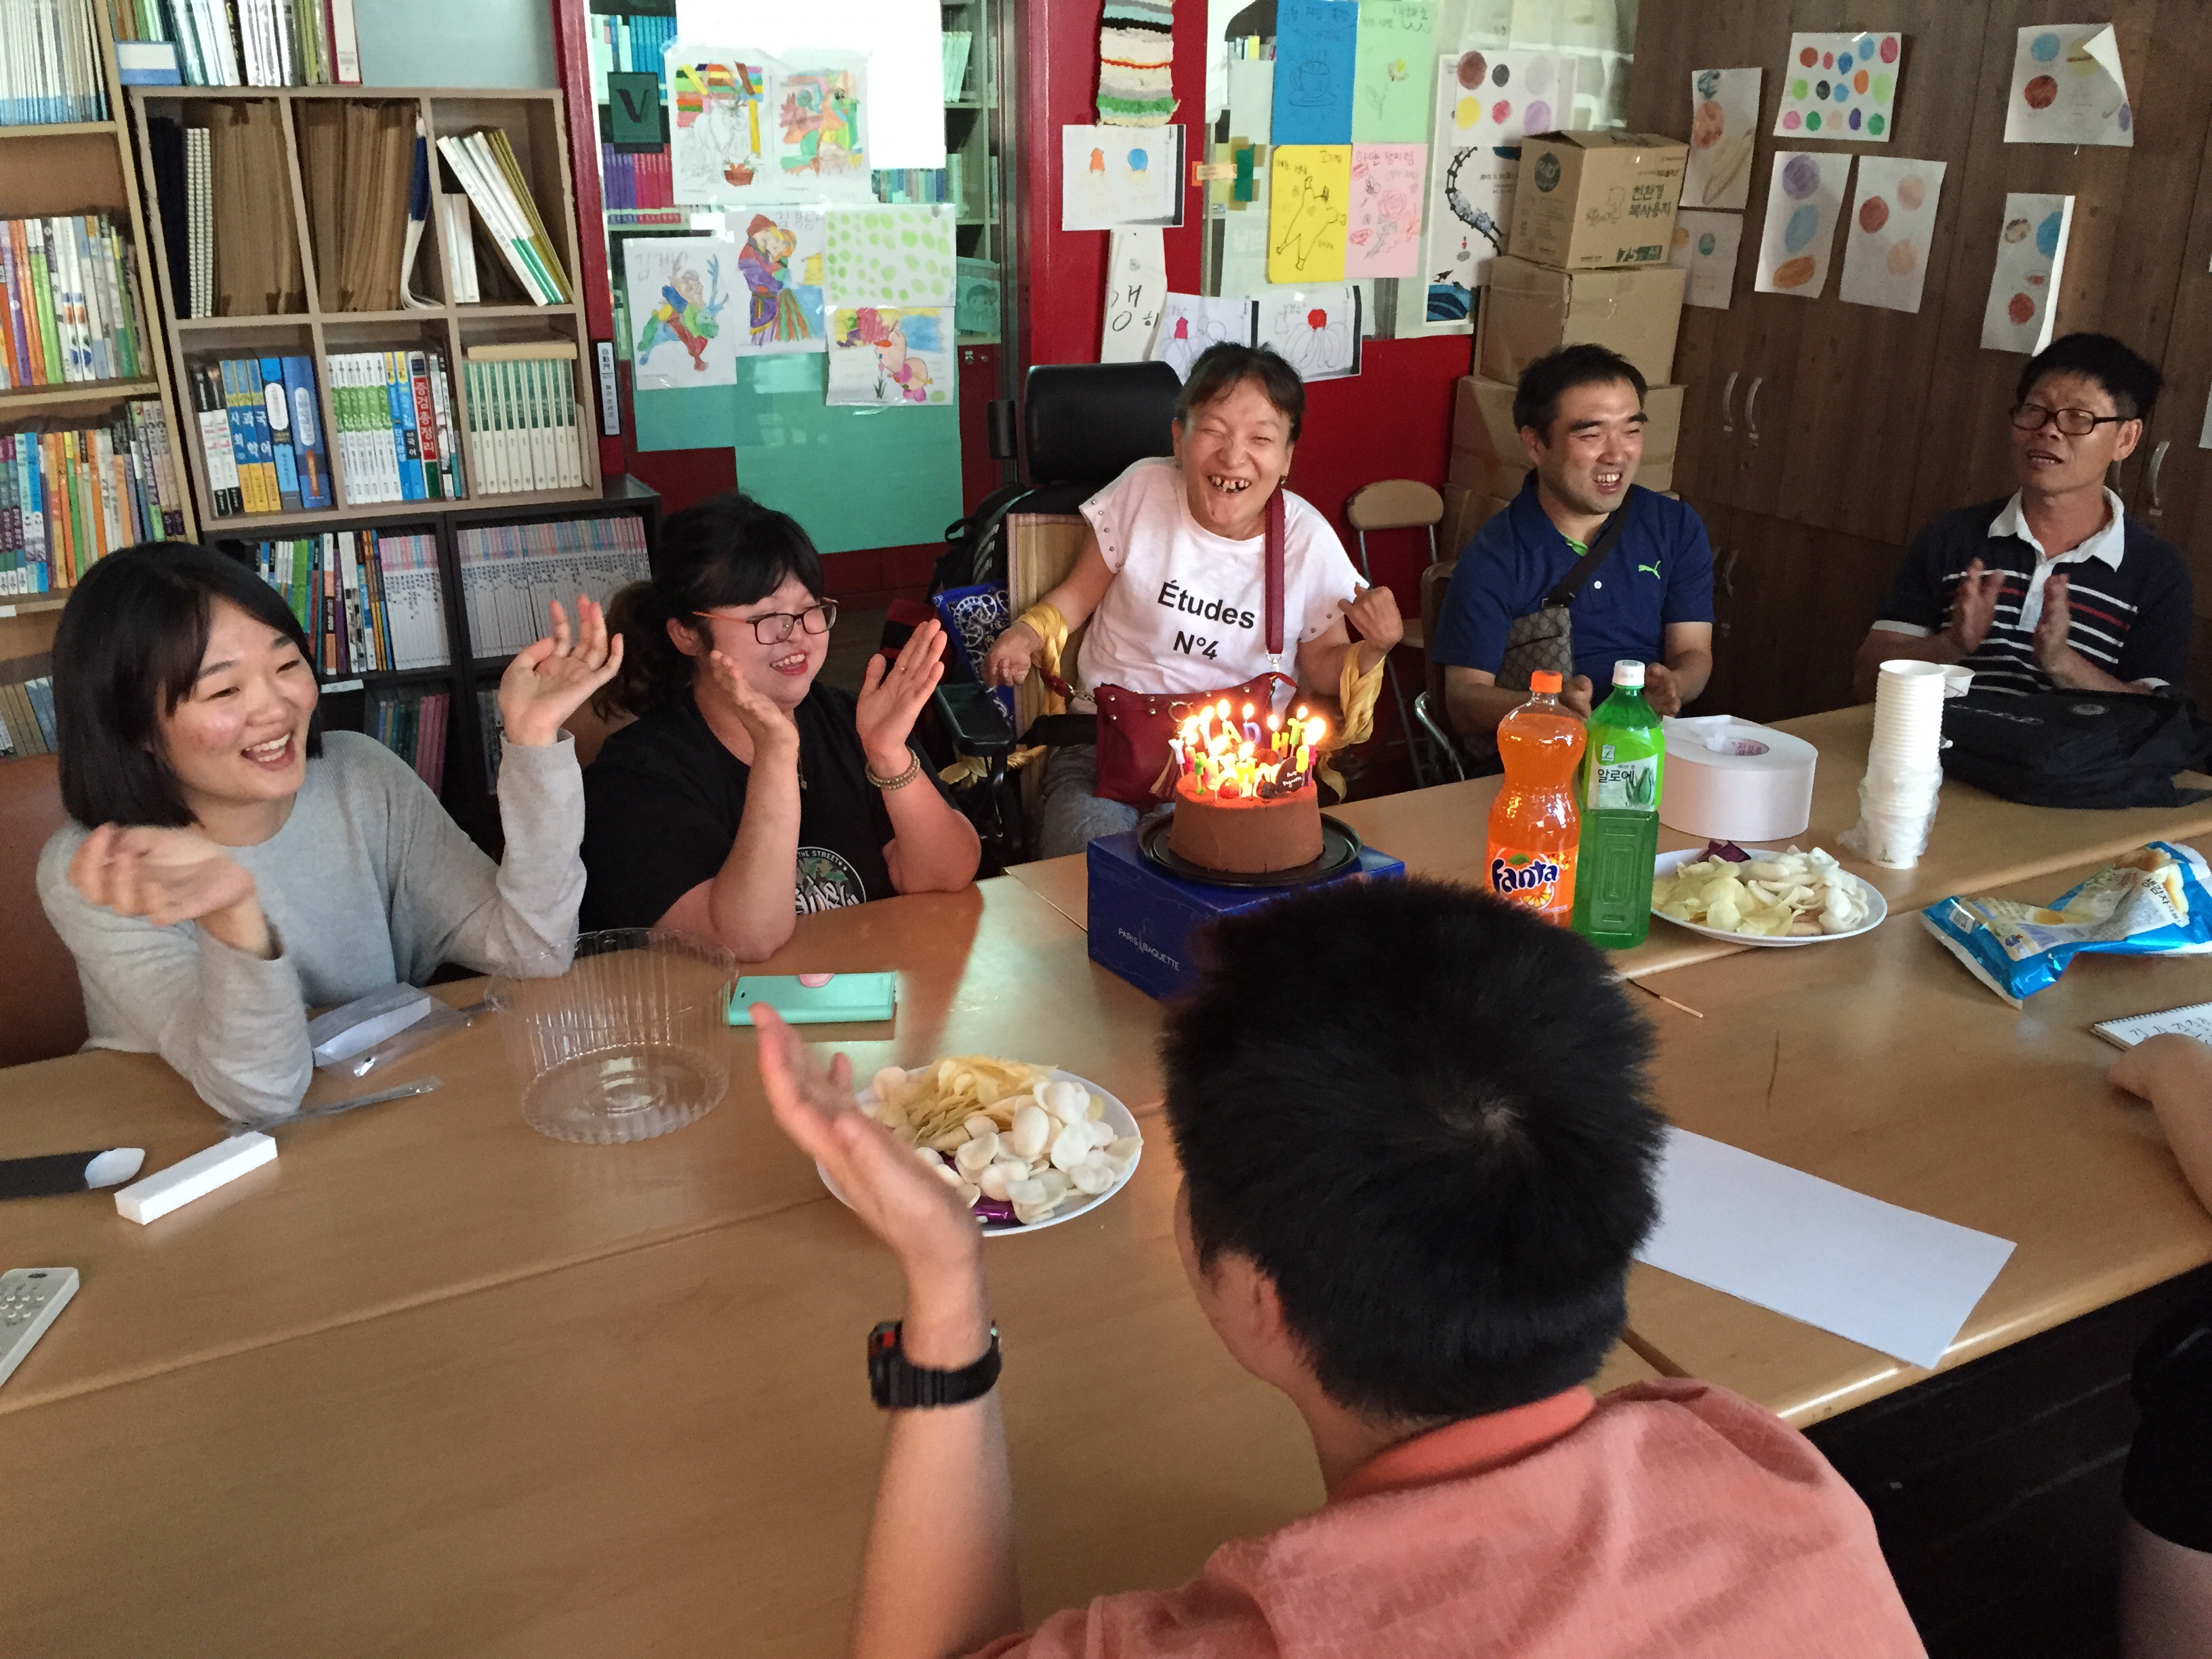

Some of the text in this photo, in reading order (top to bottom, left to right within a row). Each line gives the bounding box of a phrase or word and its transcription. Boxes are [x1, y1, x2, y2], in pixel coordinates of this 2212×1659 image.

[1632, 184, 1664, 201] 친환경
[1629, 201, 1671, 218] 복사용지
[231, 411, 244, 448] 사회
[242, 410, 259, 458] 과학
[255, 410, 272, 457] 국어
[1158, 579, 1255, 629] Études
[1597, 769, 1635, 783] 알로에
[811, 850, 840, 863] STREET
[2141, 878, 2170, 905] 생감자
[1118, 927, 1180, 971] PARIS BAGUETTE
